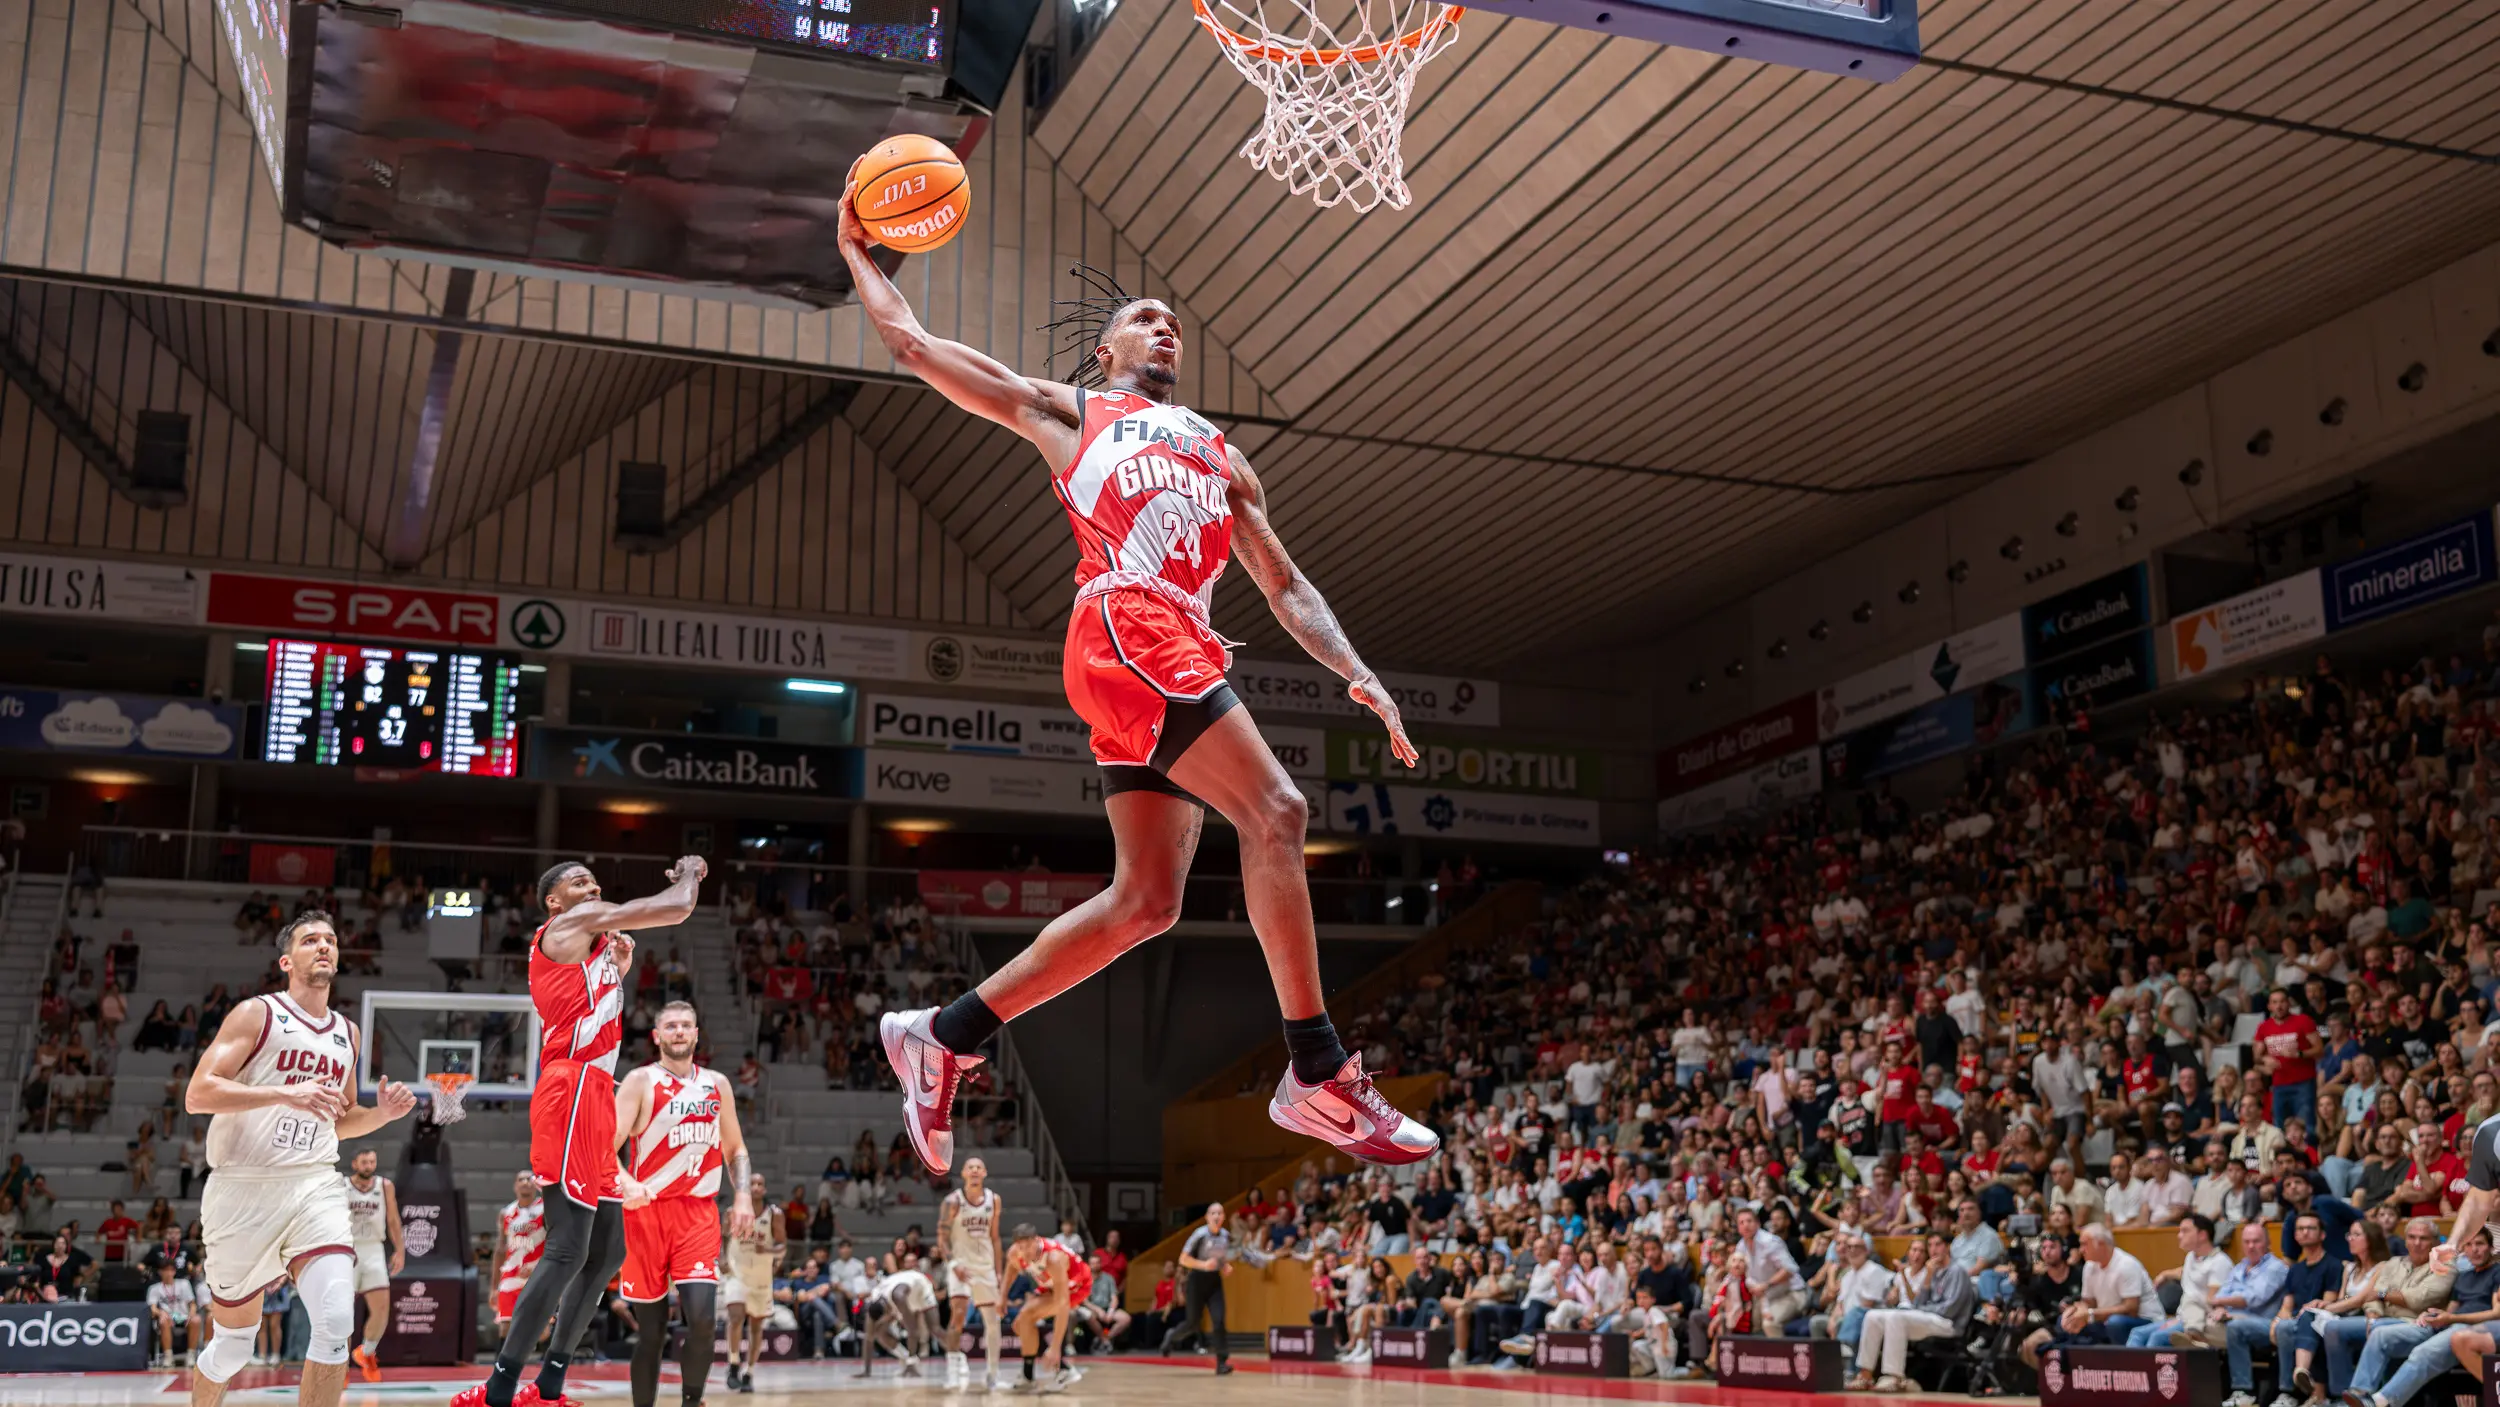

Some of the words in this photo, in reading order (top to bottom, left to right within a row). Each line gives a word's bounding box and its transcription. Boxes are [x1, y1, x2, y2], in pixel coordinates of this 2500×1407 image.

[879, 203, 957, 238] Wilson
[1113, 420, 1222, 473] FIATC
[1162, 511, 1202, 569] 24
[2348, 545, 2466, 607] mineralia
[292, 588, 493, 636] SPAR
[2057, 590, 2131, 634] CaixaBank
[641, 617, 723, 660] LLEAL
[735, 625, 826, 668] TULSÀ
[2062, 655, 2137, 698] CaixaBank
[874, 703, 1021, 743] Panella
[1738, 714, 1794, 751] Girona
[630, 742, 818, 789] CaixaBank
[877, 764, 951, 793] Kave
[1350, 739, 1578, 790] L'ESPORTIU
[276, 1049, 345, 1087] UCAM
[670, 1100, 720, 1116] FIATC
[272, 1117, 318, 1151] 99
[668, 1122, 720, 1149] GIRONA
[687, 1154, 704, 1177] 12
[402, 1205, 440, 1219] FIATC
[0, 1310, 139, 1347] ndesa
